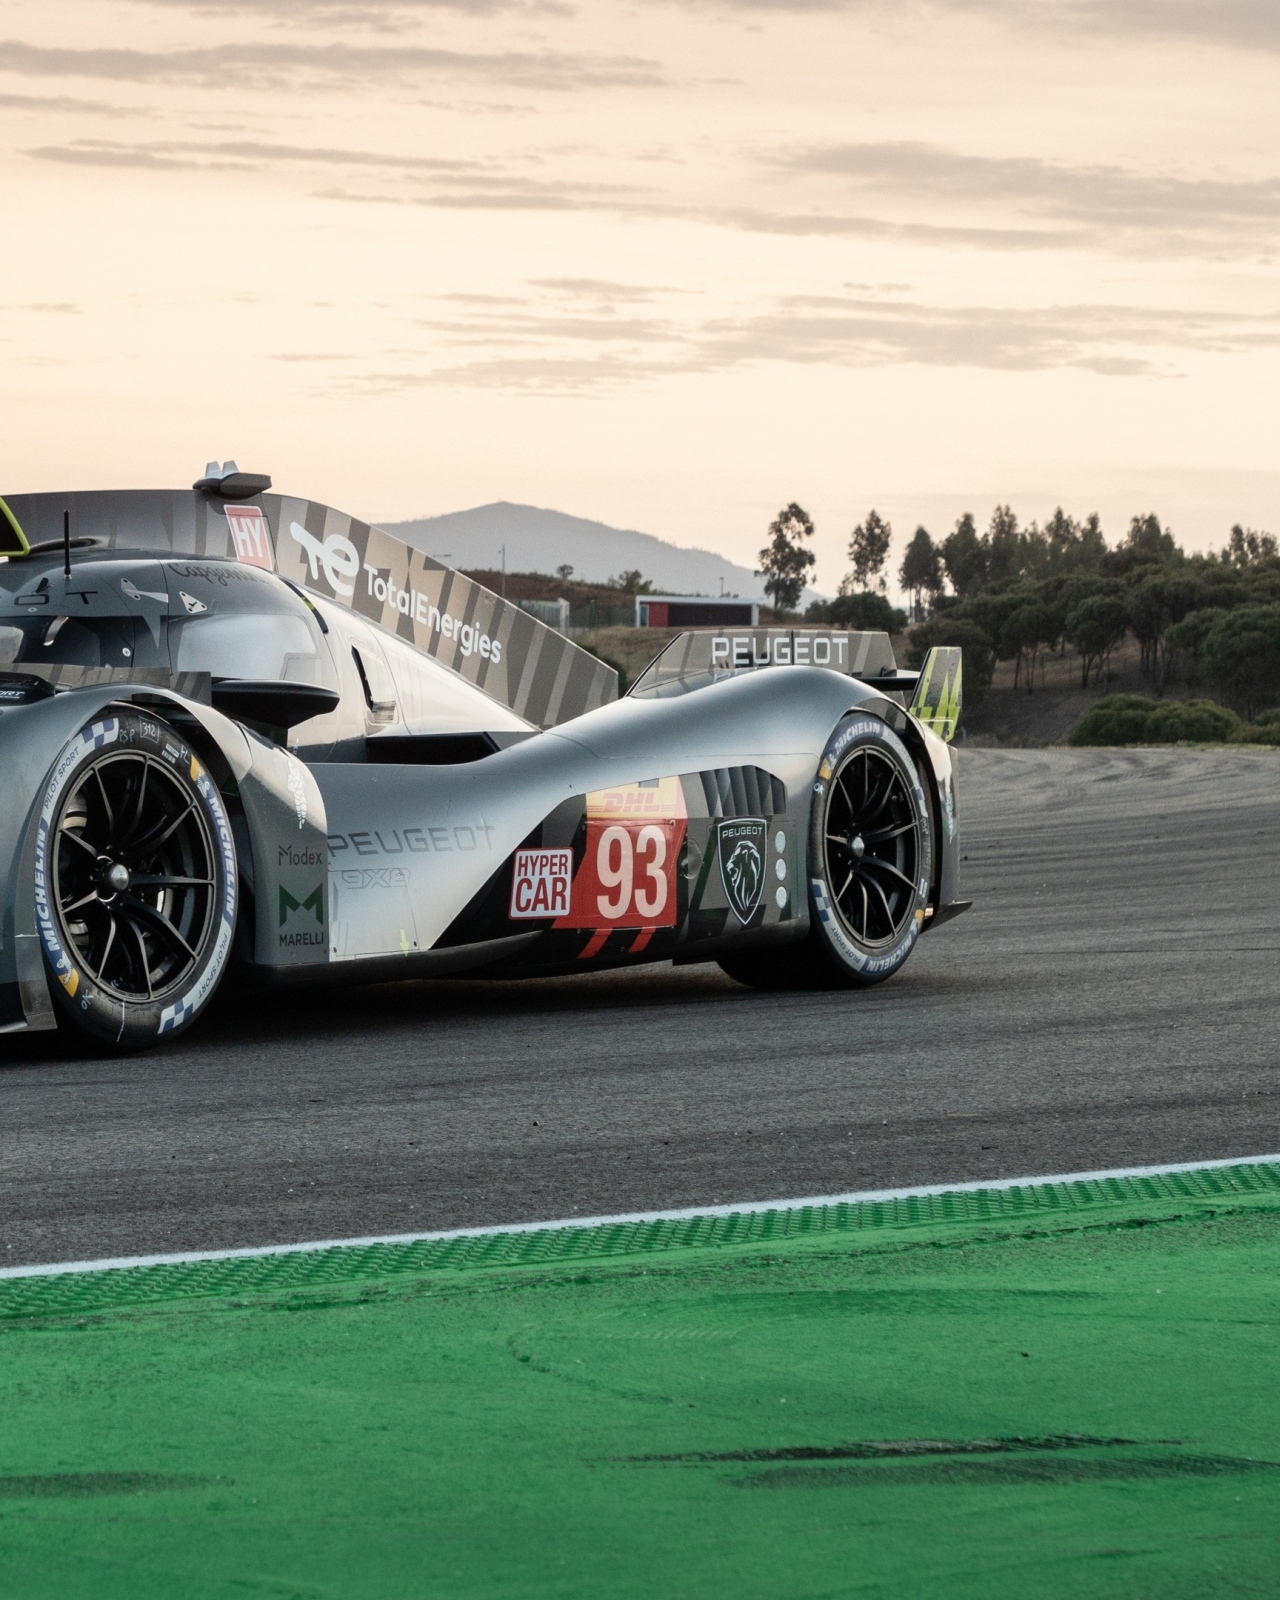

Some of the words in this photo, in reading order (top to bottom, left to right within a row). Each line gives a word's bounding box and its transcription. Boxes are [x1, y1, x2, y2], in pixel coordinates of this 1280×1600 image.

[231, 517, 263, 558] HY
[363, 563, 502, 664] TotalEnergies
[712, 637, 849, 664] PEUGEOT
[834, 722, 881, 754] MICHELIN
[44, 777, 60, 809] PILOT
[58, 747, 79, 778] SPORT
[603, 792, 661, 813] DHL
[327, 825, 496, 858] PEUGEOT
[722, 826, 763, 839] PEUGEOT
[209, 796, 235, 913] MICHELIN
[517, 854, 568, 877] HYPER
[596, 825, 668, 919] 93
[34, 830, 61, 951] MICHELIN
[515, 877, 568, 912] CAR
[214, 933, 228, 968] PILOT
[279, 932, 324, 948] MARELLI
[867, 934, 912, 972] MICHELIN
[198, 968, 218, 999] SPORT
